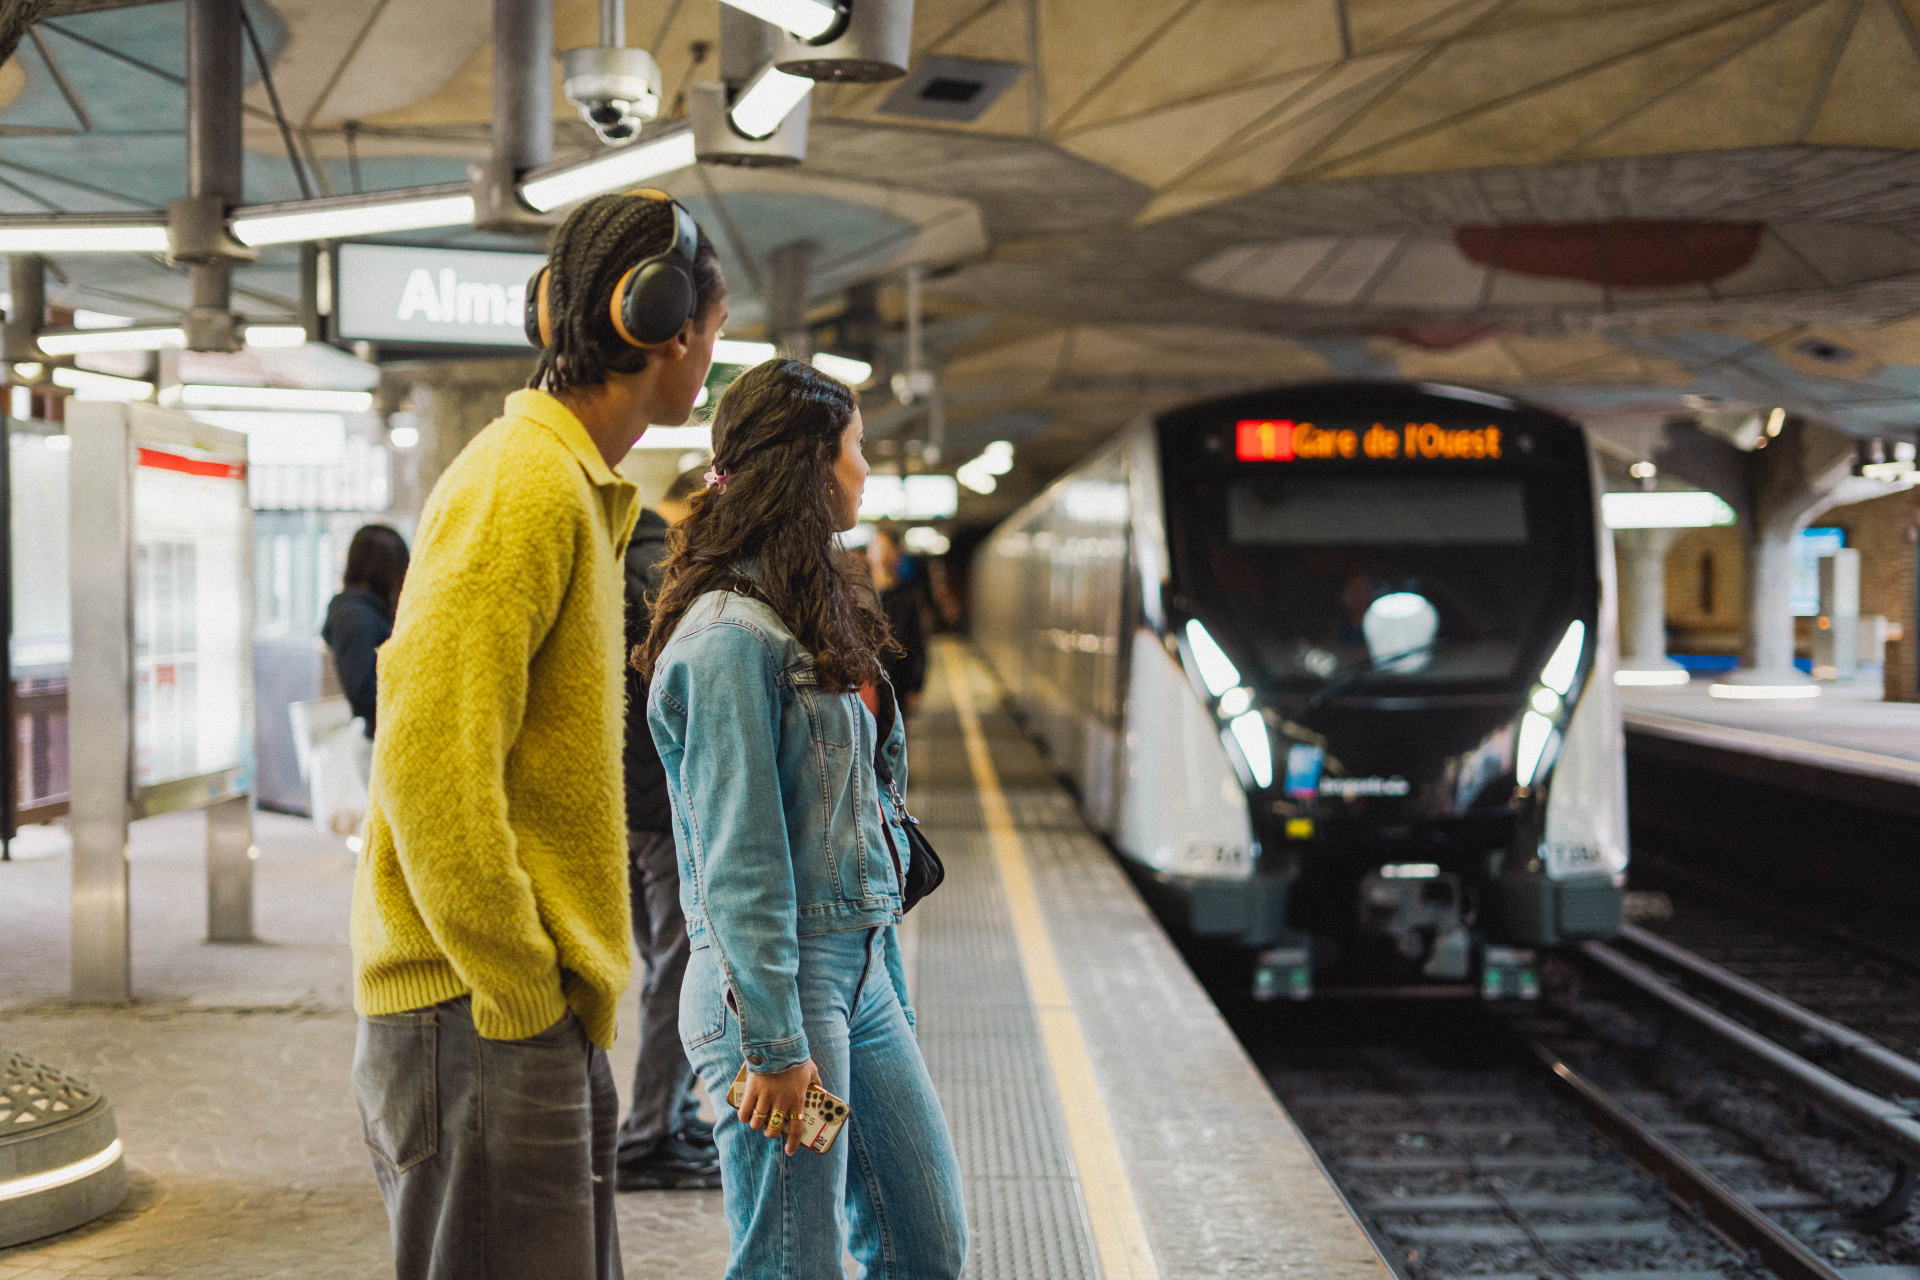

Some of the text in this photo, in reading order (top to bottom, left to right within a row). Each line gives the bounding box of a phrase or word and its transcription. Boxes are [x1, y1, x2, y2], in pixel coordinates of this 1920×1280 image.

[1257, 422, 1276, 460] 1
[1292, 422, 1358, 459] Gare
[1363, 422, 1399, 459] de
